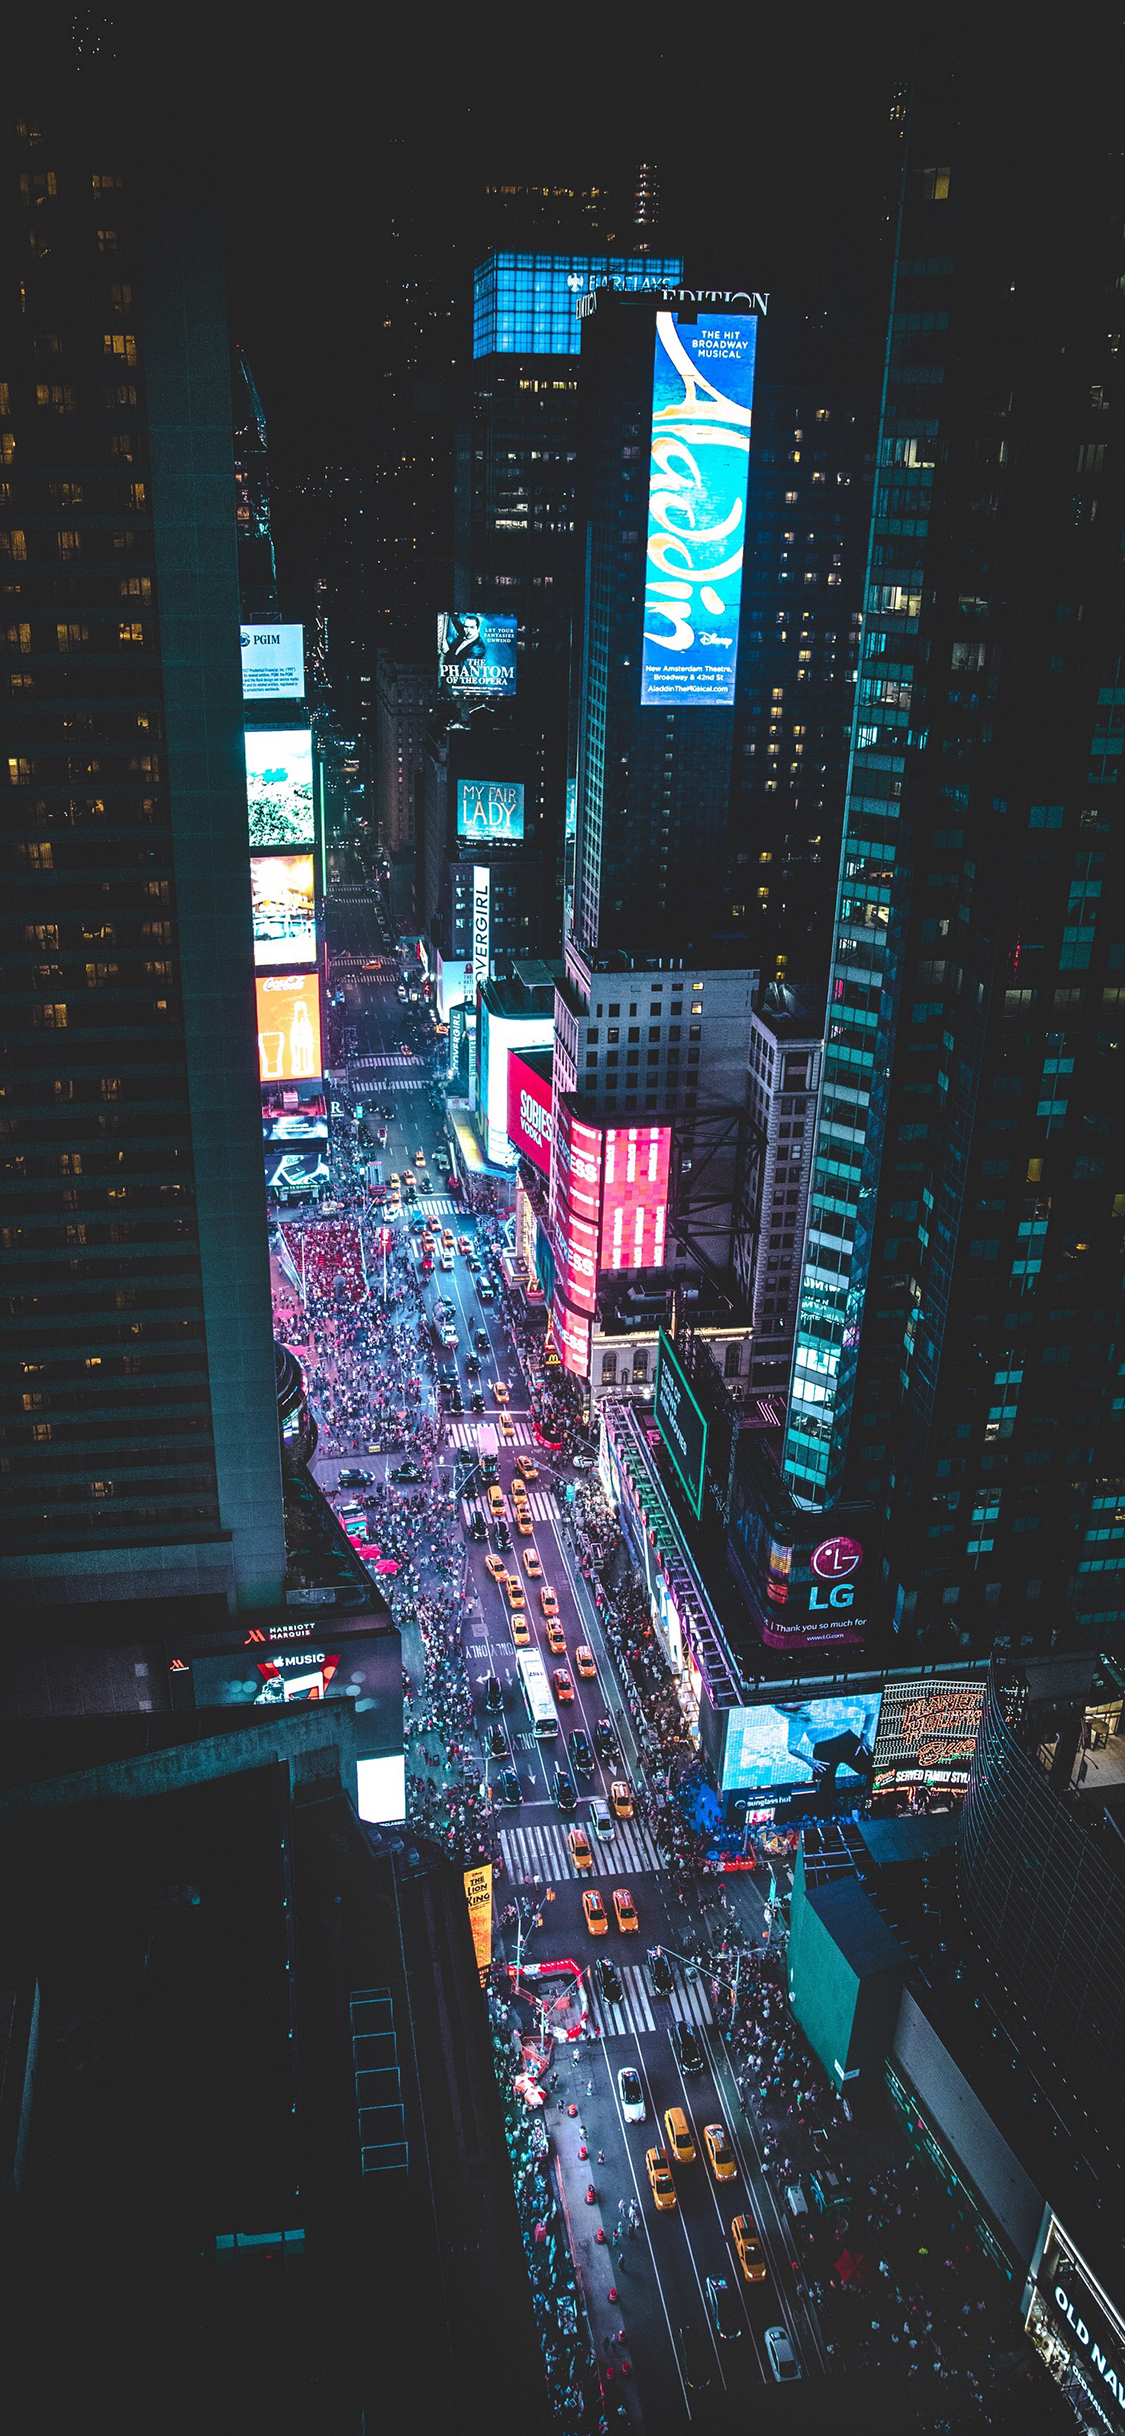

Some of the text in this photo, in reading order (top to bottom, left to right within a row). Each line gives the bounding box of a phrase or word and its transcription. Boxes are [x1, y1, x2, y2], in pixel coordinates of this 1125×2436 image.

[702, 330, 740, 340] THE HIT
[692, 340, 748, 349] BROADWAY
[698, 350, 741, 359] MUSICAL
[253, 635, 280, 645] PGIM
[698, 631, 733, 649] Disney
[440, 665, 514, 679] PHANTOM
[705, 665, 732, 673] Theatre,
[478, 677, 508, 685] OPERA
[463, 785, 516, 803] MY FAIR
[463, 800, 516, 827] LADY
[475, 885, 488, 982] OVERGIRL
[452, 1013, 461, 1071] COVERGIRL
[331, 1101, 342, 1113] R
[520, 1089, 552, 1142] SOBIES
[520, 1116, 542, 1148] VODKA
[808, 1583, 855, 1610] LG
[269, 1622, 315, 1634] MARRIOTT
[776, 1624, 800, 1632] Thank
[801, 1623, 817, 1632] you
[830, 1619, 853, 1628] much
[854, 1618, 867, 1626] for
[269, 1630, 311, 1640] MARQUIS
[465, 1645, 488, 1659] ONLY
[285, 1653, 325, 1667] MUSIC
[902, 1693, 984, 1729] PLANET
[896, 1769, 924, 1783] SERVED
[924, 1769, 951, 1783] FAMILY
[747, 1796, 792, 1807] sunglass hut
[470, 1876, 485, 1886] THE
[468, 1883, 487, 1896] LION
[467, 1892, 490, 1907] KING
[1055, 2286, 1089, 2345] OLD
[1072, 2365, 1109, 2424] OLD NAVY
